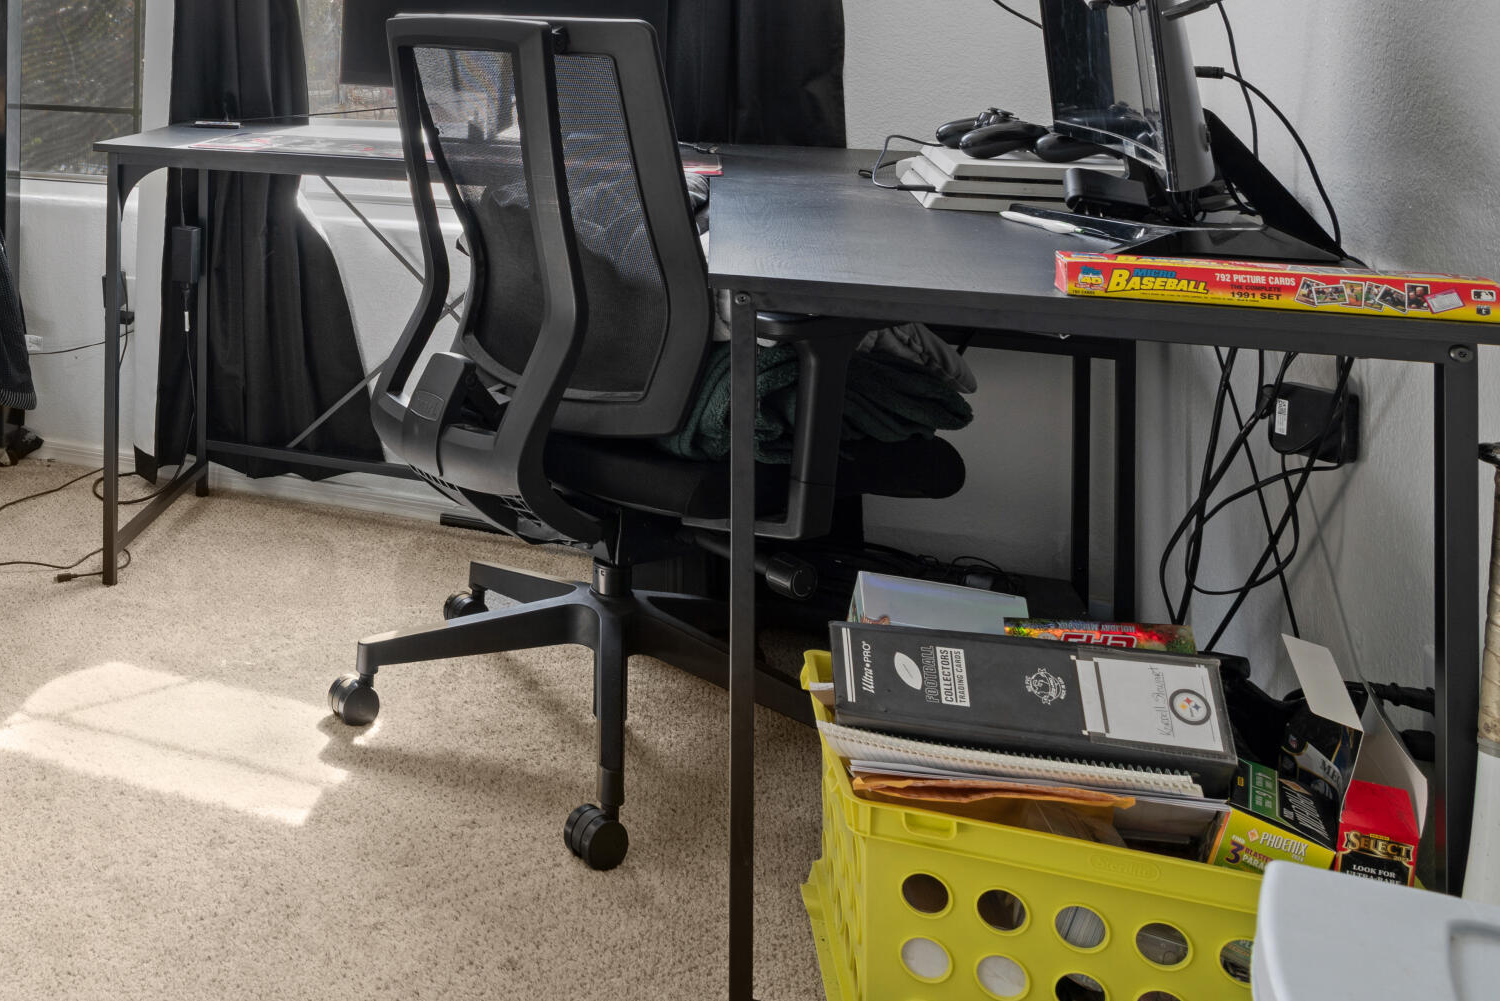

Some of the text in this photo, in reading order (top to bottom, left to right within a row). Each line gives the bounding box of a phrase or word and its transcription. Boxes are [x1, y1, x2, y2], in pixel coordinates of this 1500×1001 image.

[1106, 268, 1209, 294] BASEBALL
[1133, 268, 1177, 278] MICRO
[1214, 273, 1296, 286] 792 PICTURE CARDS
[1231, 291, 1256, 299] 1991
[1260, 292, 1282, 300] SET
[920, 645, 940, 703] FOOTBALL
[939, 649, 954, 703] COLLECTORS
[954, 650, 966, 703] TRADING CARDS
[1225, 840, 1245, 864] 3
[1244, 847, 1273, 862] BLASTE
[1260, 832, 1308, 856] PHOENIX
[1349, 831, 1408, 857] SELECT
[1352, 864, 1397, 879] LOOK FOR
